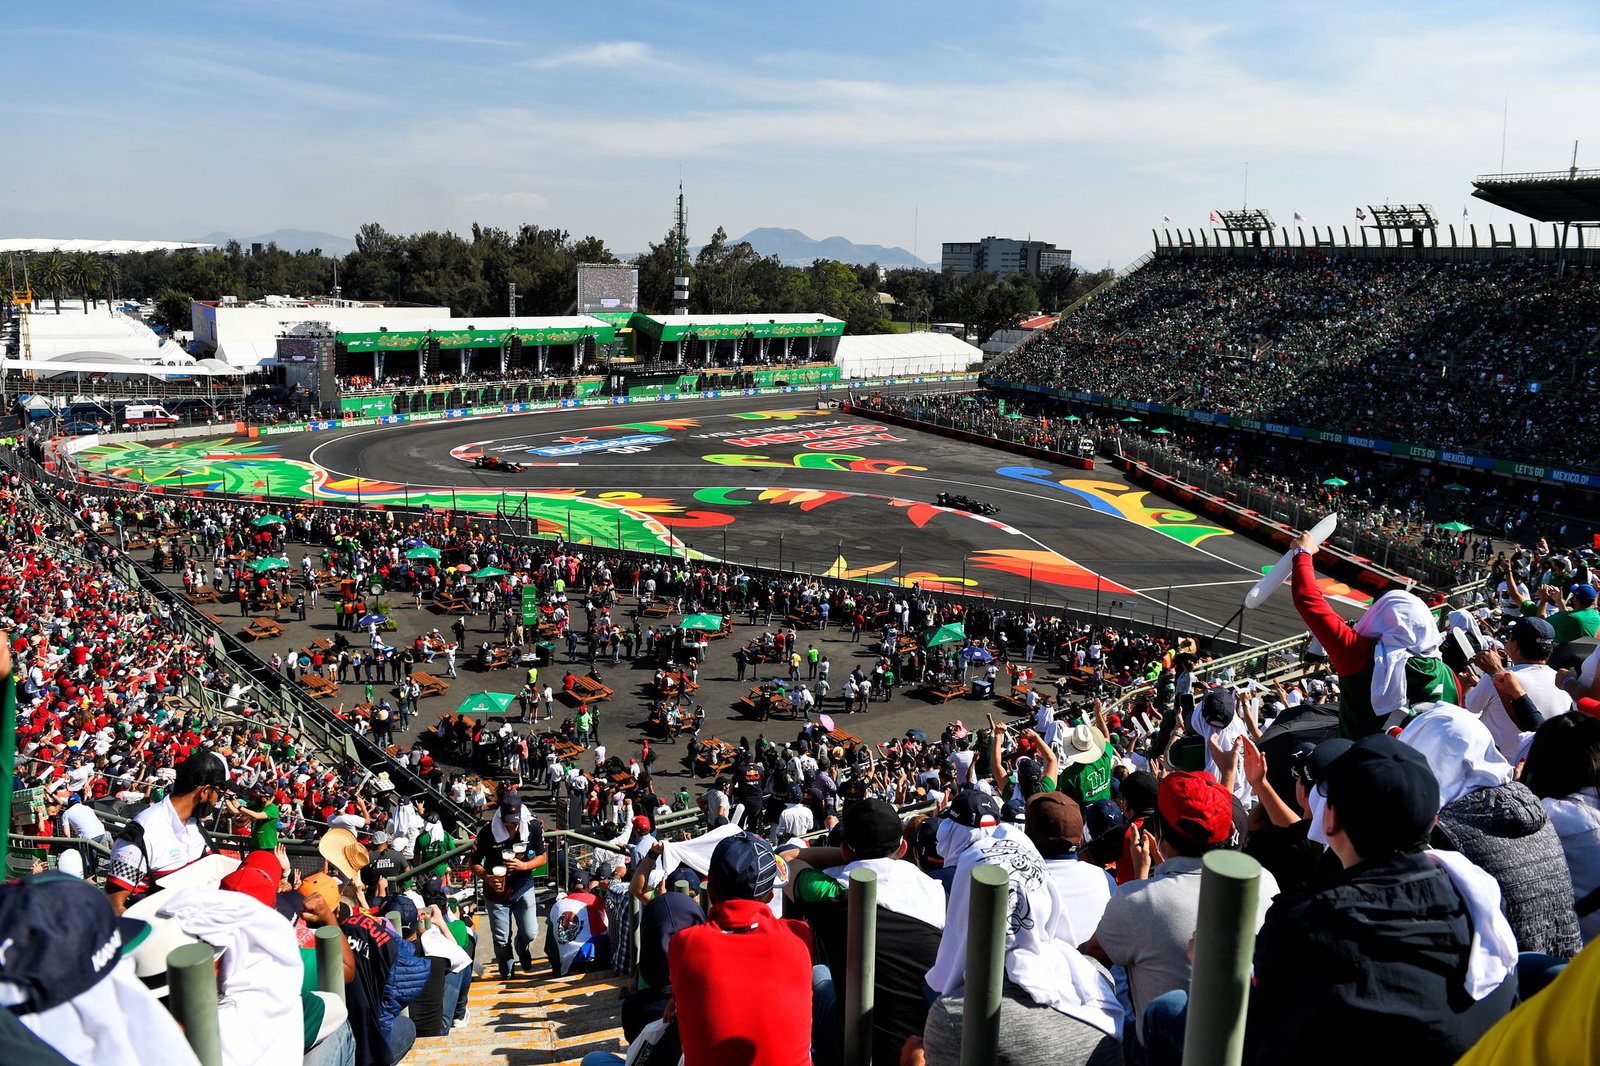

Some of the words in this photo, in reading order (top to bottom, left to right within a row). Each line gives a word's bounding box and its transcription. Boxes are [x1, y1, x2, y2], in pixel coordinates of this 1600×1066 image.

[529, 401, 557, 409] Heineken
[472, 406, 501, 415] Heineken
[409, 413, 441, 421] Heineken
[341, 418, 375, 428] Heineken
[1241, 418, 1254, 428] LET'S
[267, 425, 304, 435] Heineken
[723, 424, 888, 447] MEXICO
[1320, 431, 1334, 440] LET'S
[803, 433, 907, 450] CITY
[1410, 446, 1426, 456] LET'S
[1515, 463, 1534, 475] LET'S
[1087, 767, 1106, 790] 11
[360, 916, 393, 948] Bull
